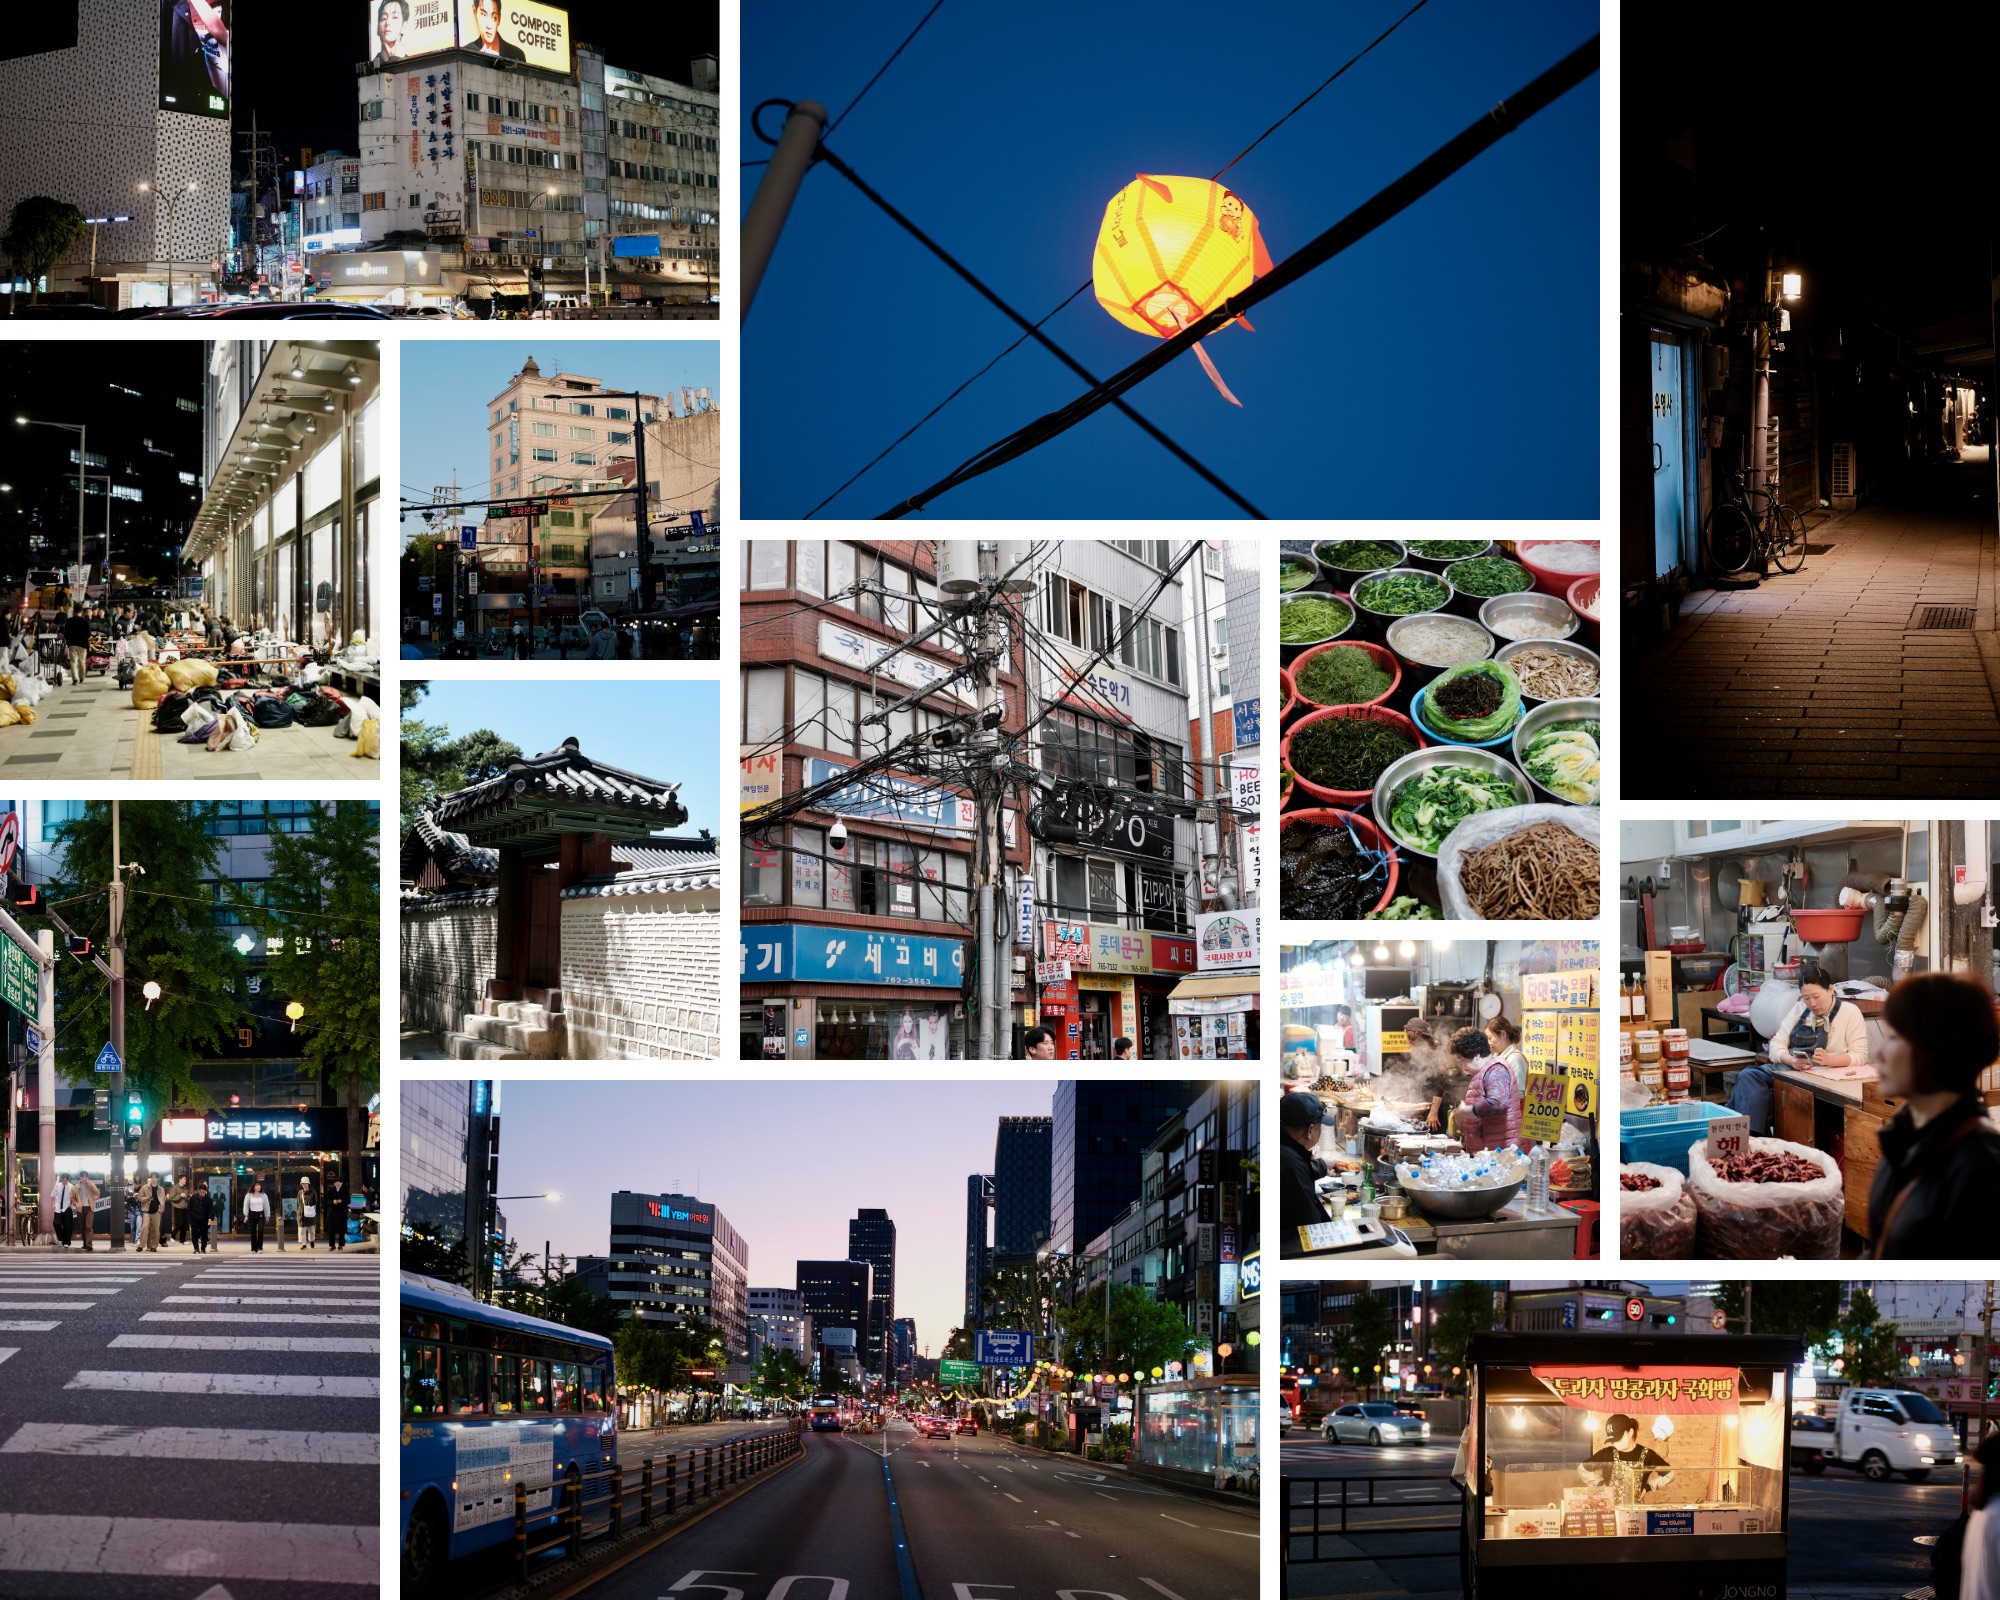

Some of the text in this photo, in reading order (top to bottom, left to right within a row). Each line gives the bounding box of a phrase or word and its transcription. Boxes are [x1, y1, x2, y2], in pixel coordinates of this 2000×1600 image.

[414, 11, 449, 30] 커피답게
[511, 11, 562, 37] COMPOSE
[517, 30, 557, 51] COFFEE
[1654, 392, 1673, 417] 우영사
[510, 506, 539, 516] 돈화문로
[1088, 673, 1130, 706] 수도악기
[1147, 819, 1159, 828] 지포
[1162, 845, 1172, 857] 2F
[795, 854, 820, 867] 고급시계
[795, 866, 820, 879] 귀금속
[795, 879, 820, 891] 카메라
[1090, 873, 1116, 901] ZIPPO
[1143, 880, 1172, 907] ZIPPO
[831, 887, 852, 903] 전문
[1022, 884, 1033, 941] 스포츠
[1053, 942, 1091, 965] 부동산
[1098, 934, 1145, 960] 롯데문구
[1170, 946, 1192, 965] 씨티
[1203, 950, 1252, 962] 국제시장 포차
[1037, 961, 1065, 975] 전당포
[1046, 1005, 1066, 1016] 부동산
[1142, 996, 1151, 1046] ZIPPO
[797, 1034, 807, 1042] ADT
[1528, 1075, 1565, 1105] 식혜
[1528, 1103, 1560, 1118] 2,000
[207, 1121, 312, 1139] 한국금거래소
[1711, 1122, 1748, 1133] 원산지:한국
[1223, 1225, 1236, 1255] 스피치
[1222, 1271, 1234, 1304] 보청기
[1630, 1304, 1641, 1315] 50
[984, 1355, 1024, 1365] 중앙차로버스전용
[1547, 1377, 1735, 1401] 두과자 땅콩과자 국화빵
